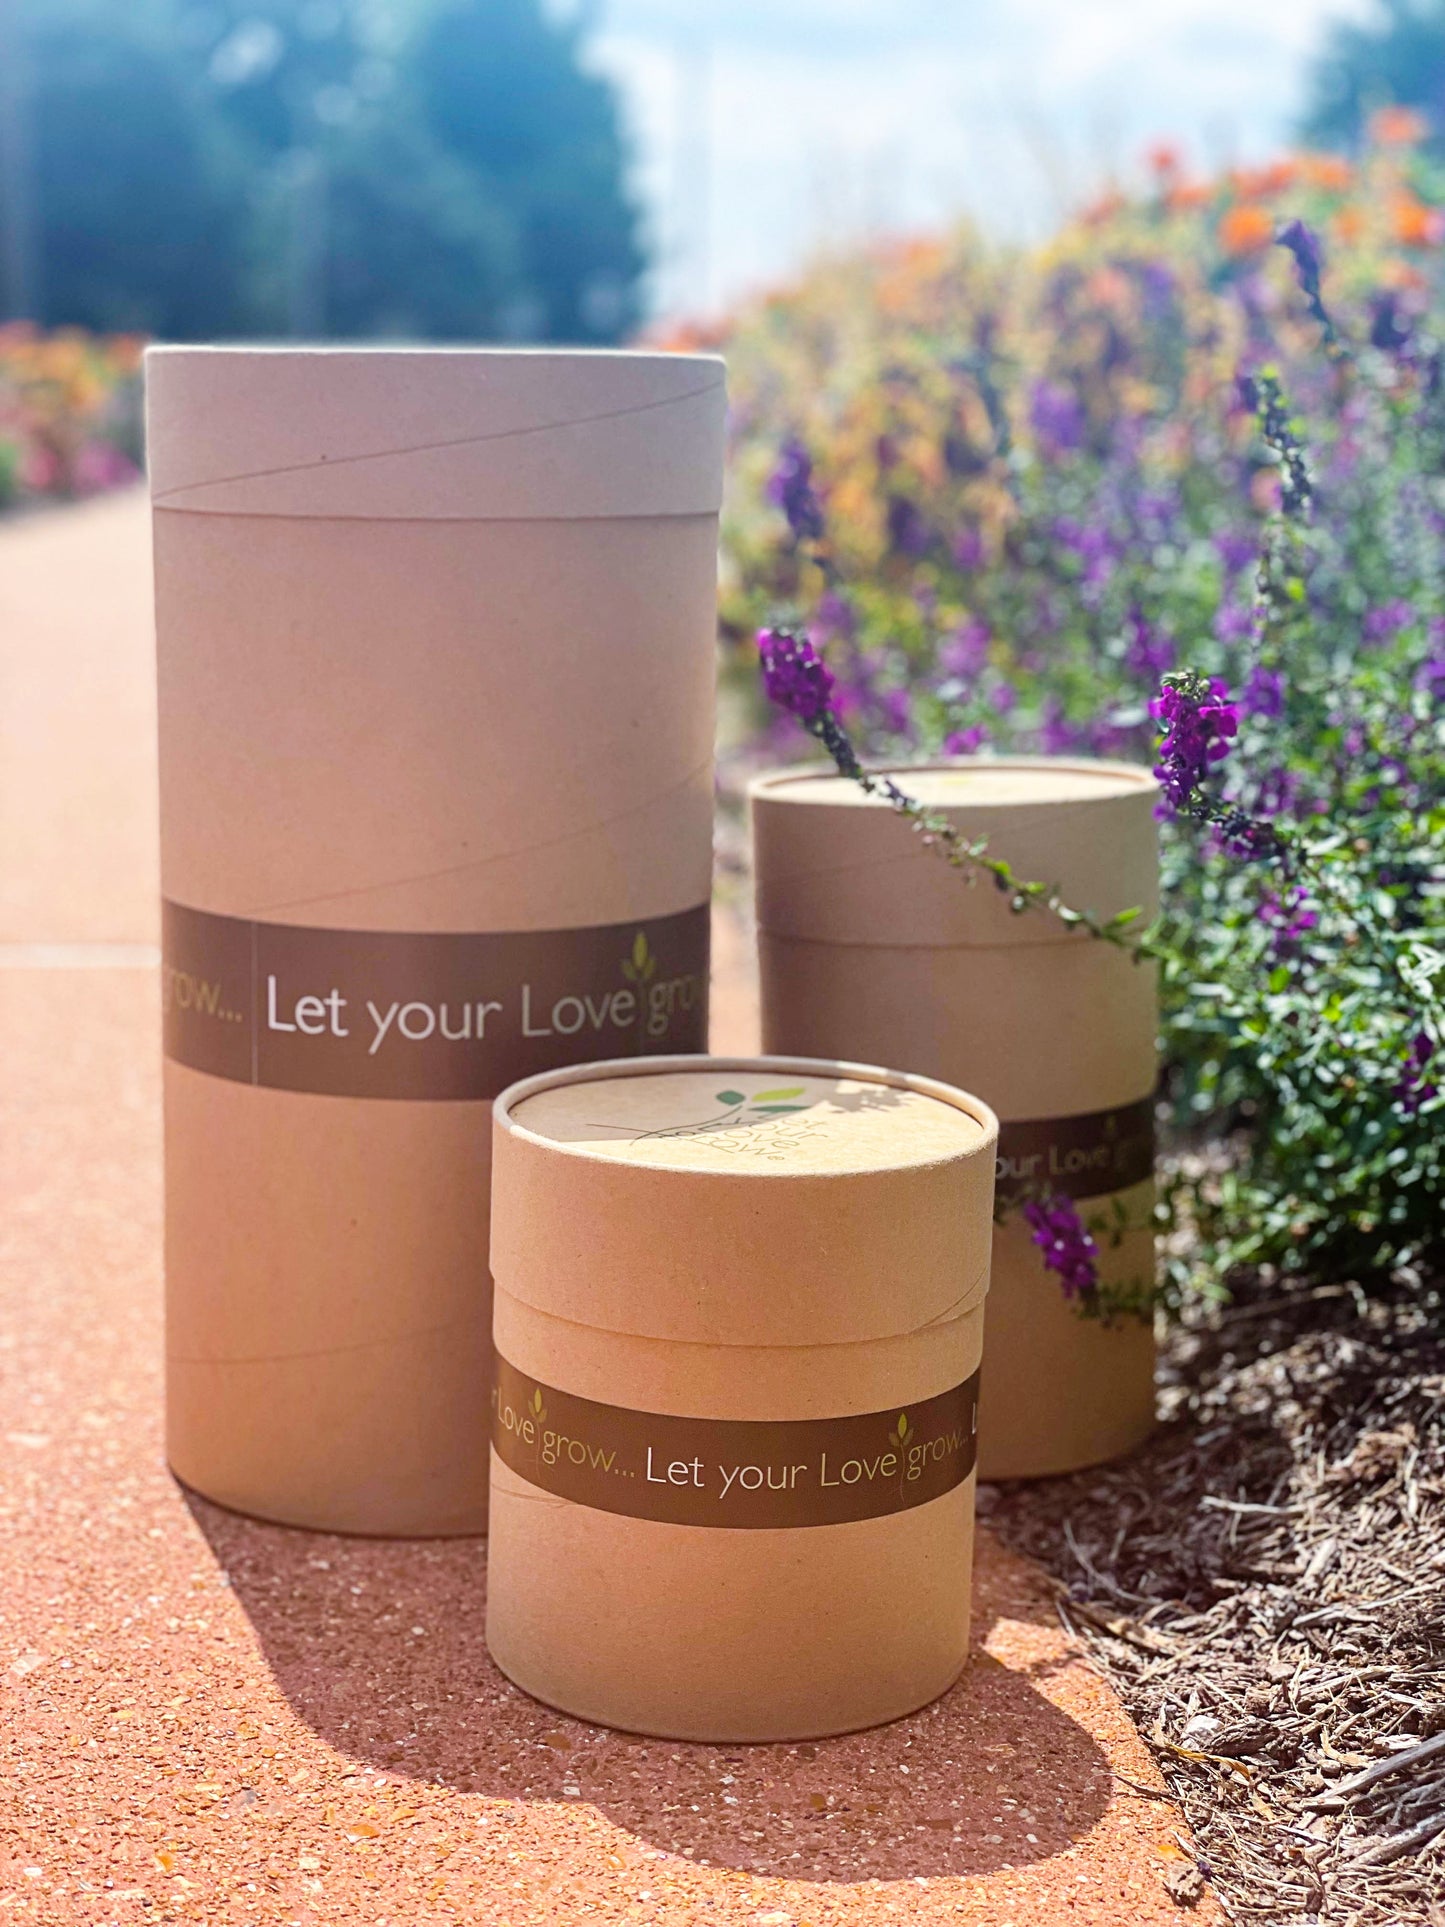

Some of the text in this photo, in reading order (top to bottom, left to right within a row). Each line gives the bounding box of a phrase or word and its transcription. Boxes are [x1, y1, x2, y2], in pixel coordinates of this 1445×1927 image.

[164, 961, 696, 1055] row... Let your Love gro
[697, 1123, 801, 1149] Love
[995, 1154, 1042, 1180] our
[498, 1385, 535, 1445] Love
[541, 1430, 636, 1478] grow...
[646, 1446, 705, 1487] Let
[718, 1464, 808, 1500] your
[820, 1452, 897, 1486] Love
